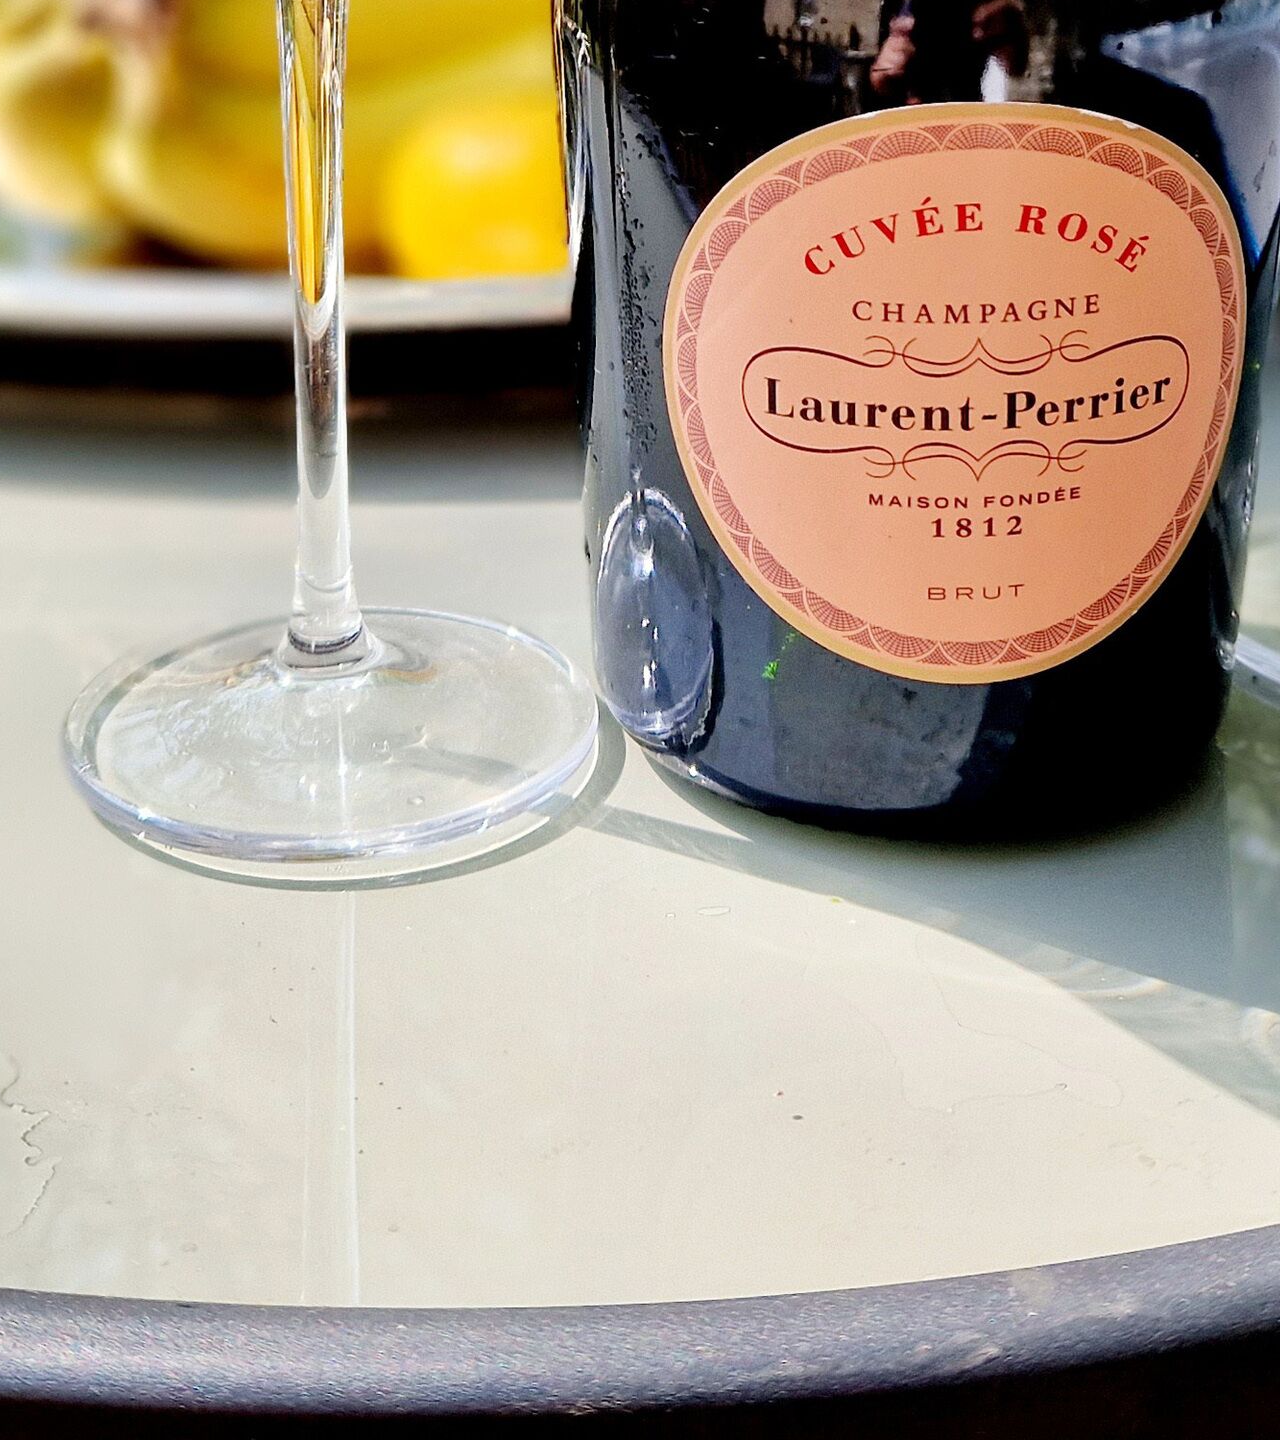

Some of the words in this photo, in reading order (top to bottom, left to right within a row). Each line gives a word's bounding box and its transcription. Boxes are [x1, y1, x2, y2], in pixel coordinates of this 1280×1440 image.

[803, 196, 983, 277] CUVÉE
[1015, 203, 1151, 274] ROSÉ
[852, 293, 1101, 325] CHAMPAGNE
[763, 374, 1172, 432] Laurent-Perrier
[868, 492, 969, 510] MAISON
[983, 486, 1082, 509] FONDÉE
[930, 515, 1023, 539] 1812
[927, 583, 1025, 601] BRUT
